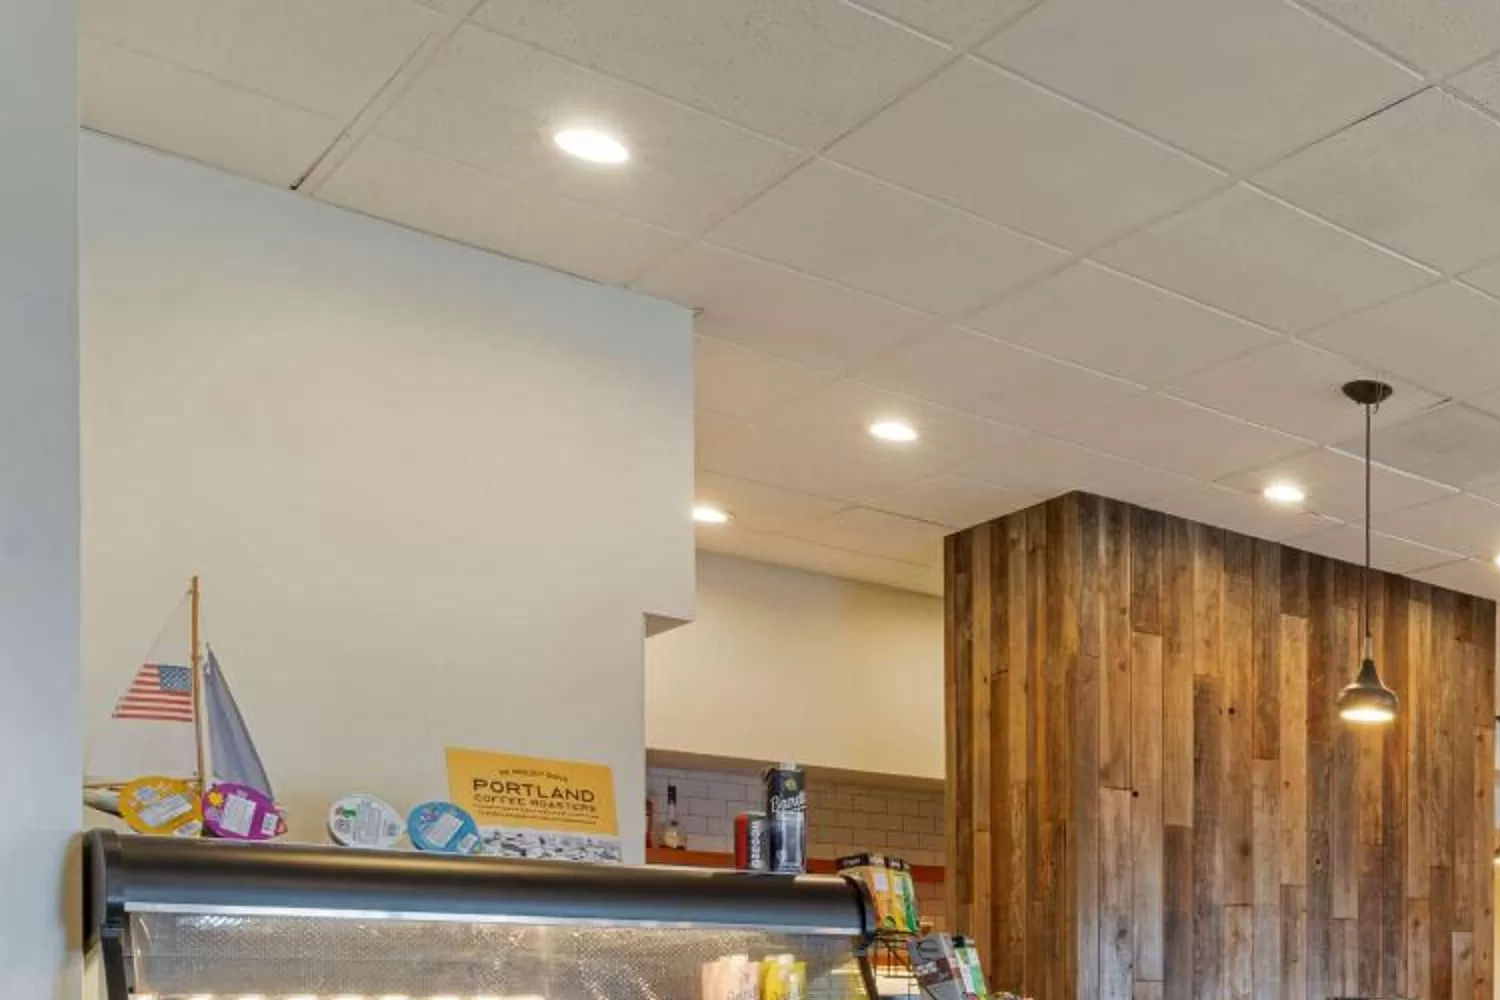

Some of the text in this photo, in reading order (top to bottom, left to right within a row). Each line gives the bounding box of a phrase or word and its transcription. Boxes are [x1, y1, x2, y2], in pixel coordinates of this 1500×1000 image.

[473, 777, 596, 804] PORTLAND
[474, 793, 527, 806] COFFEE
[530, 798, 597, 813] ROASTERS
